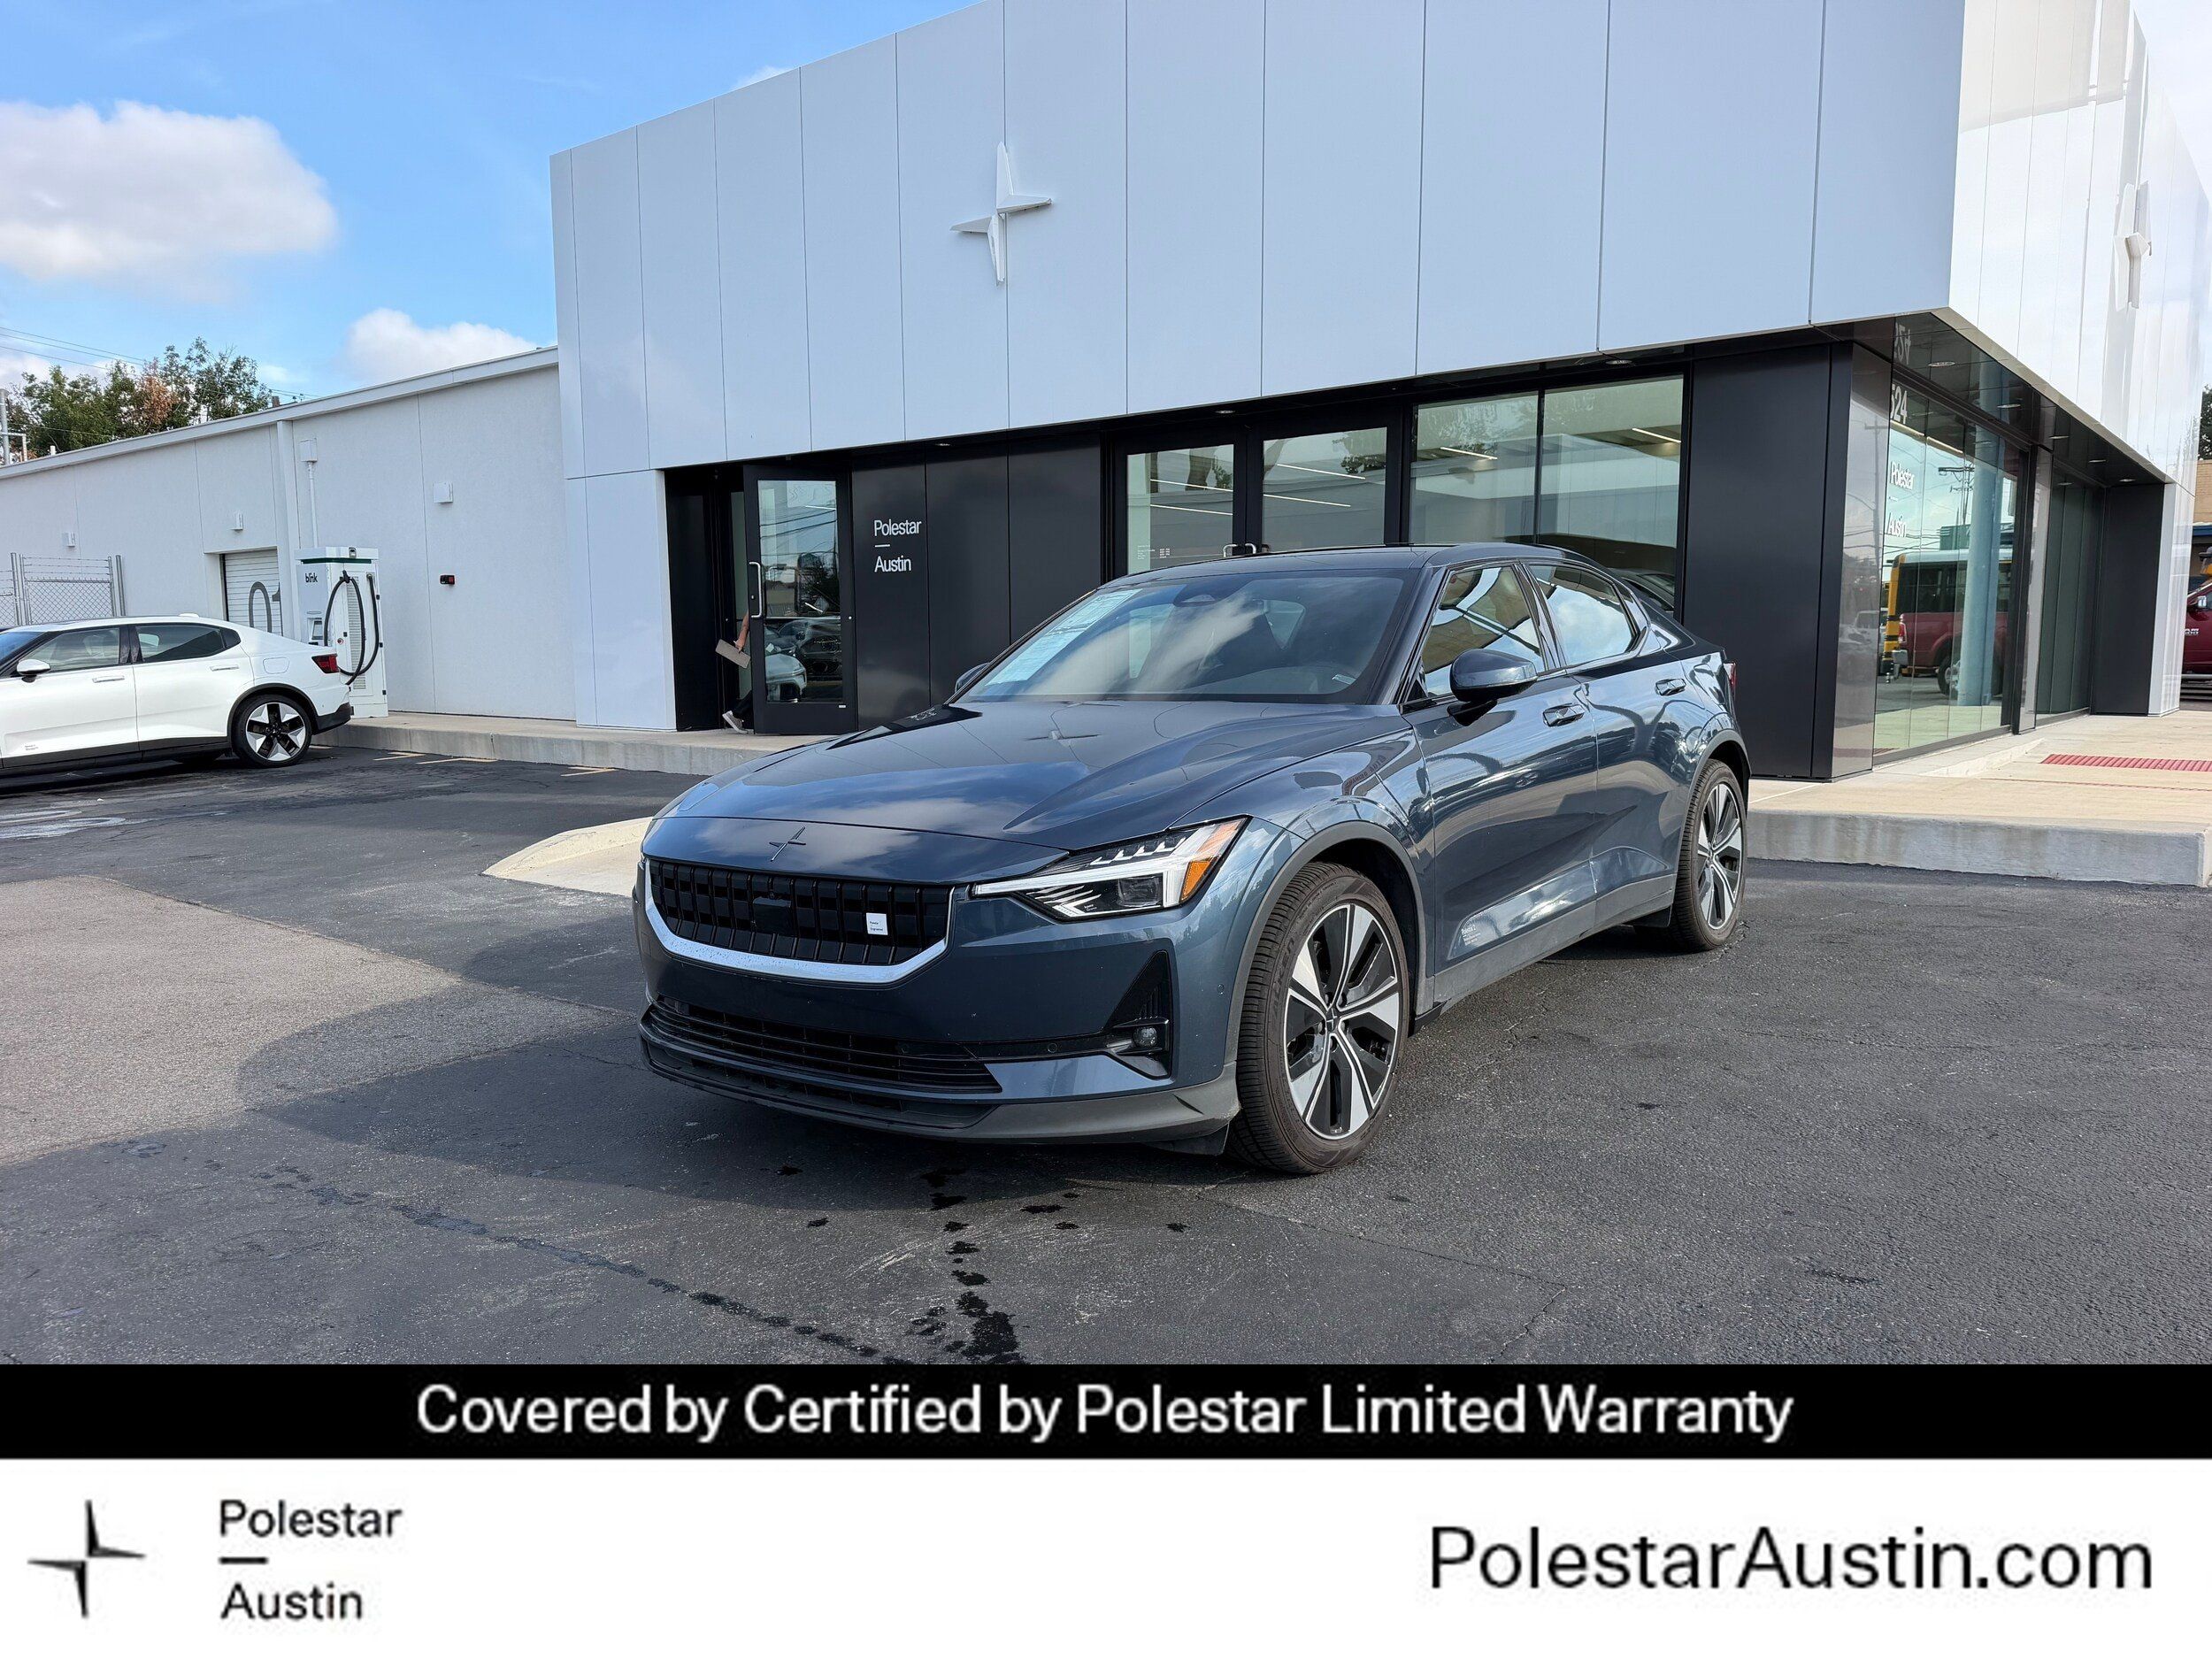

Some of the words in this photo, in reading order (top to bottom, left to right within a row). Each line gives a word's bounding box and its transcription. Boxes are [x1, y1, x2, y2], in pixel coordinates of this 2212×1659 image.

[1890, 461, 1915, 491] Polestar
[873, 518, 922, 537] Polestar
[1886, 512, 1907, 538] Austin
[873, 555, 912, 572] Austin
